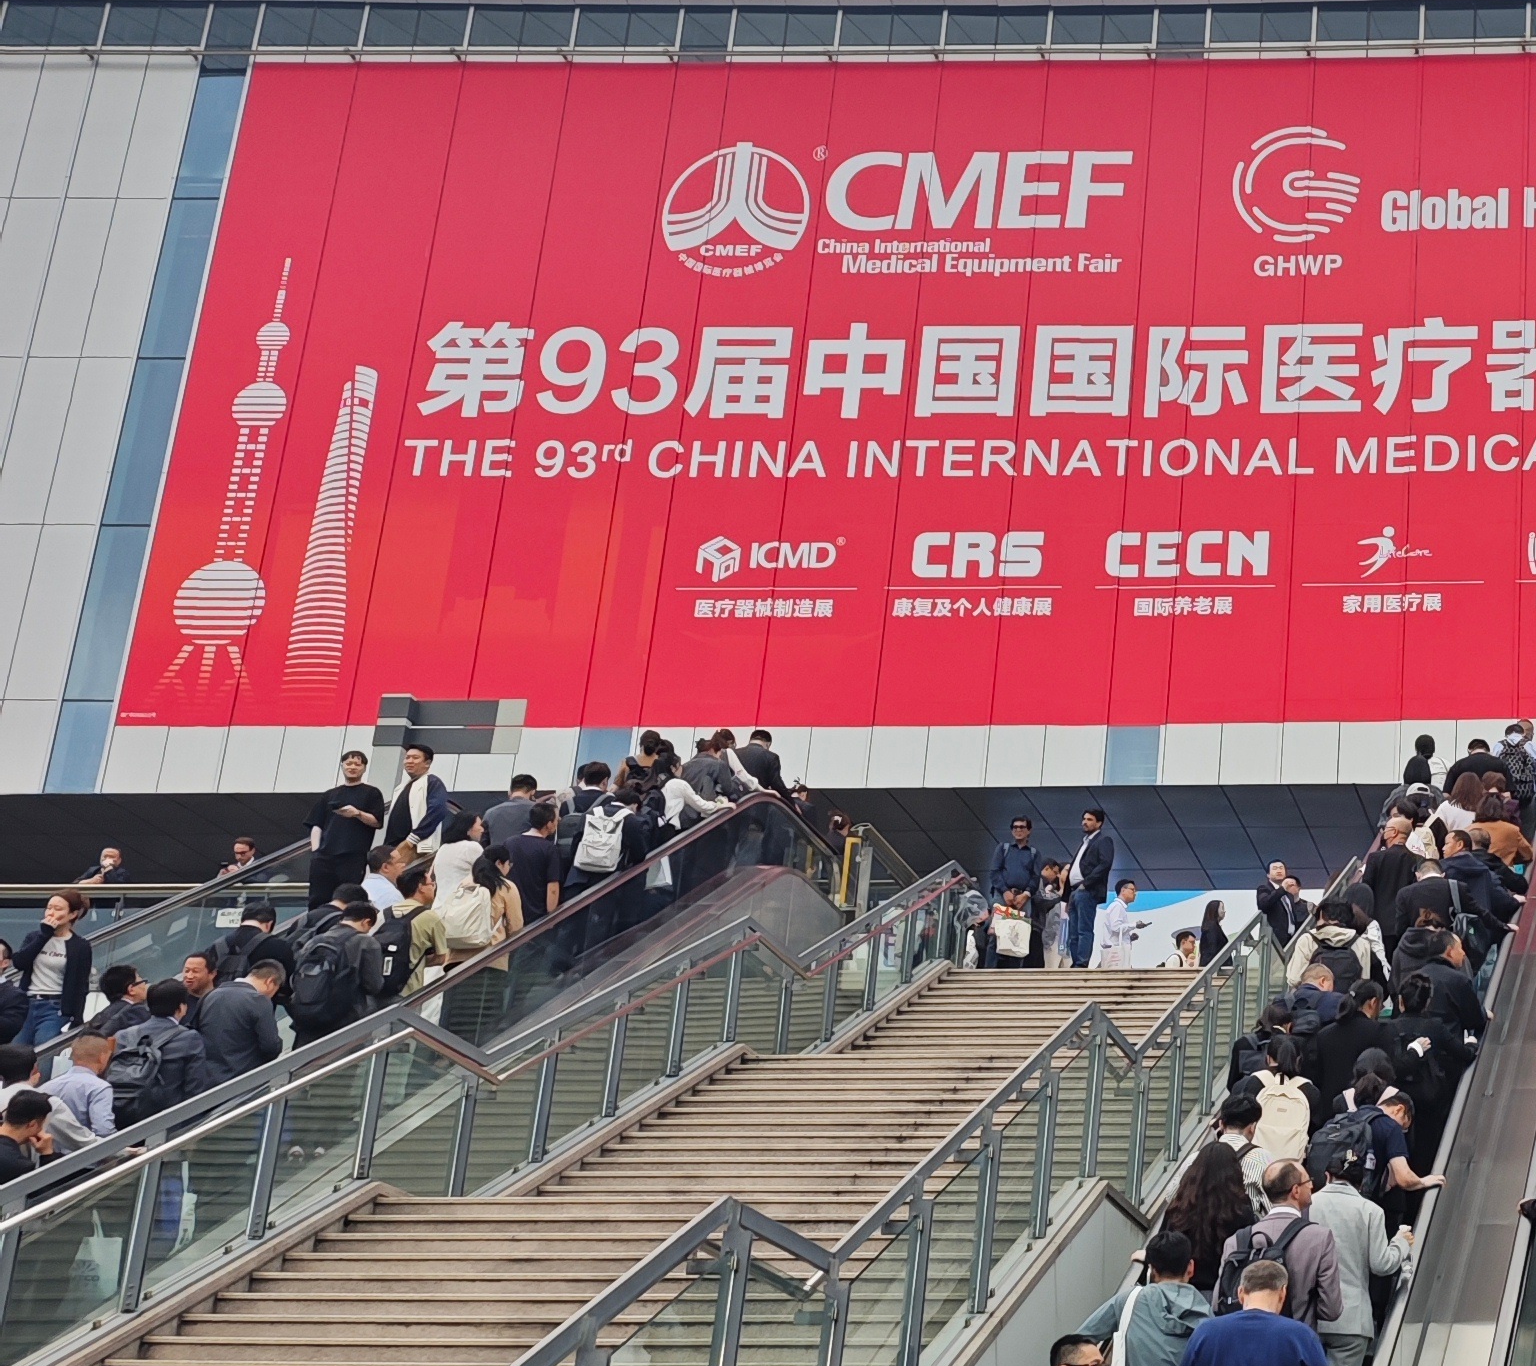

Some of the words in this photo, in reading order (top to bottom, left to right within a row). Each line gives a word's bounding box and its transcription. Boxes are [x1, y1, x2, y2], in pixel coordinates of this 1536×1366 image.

[826, 151, 1133, 231] CMEF
[1381, 188, 1509, 232] Global
[699, 244, 763, 257] CMEF
[818, 238, 868, 255] China
[873, 237, 991, 254] International
[841, 253, 938, 274] Medical
[944, 253, 1072, 277] Equipment
[1078, 253, 1122, 272] Fair
[1254, 255, 1342, 276] GHWP
[405, 439, 515, 477] THE
[649, 441, 826, 478] CHINA
[847, 438, 1314, 477] INTERNATIONAL
[750, 542, 836, 568] ICMD
[912, 532, 1044, 578] CRS
[1105, 531, 1269, 577] CECN
[694, 598, 833, 617] 医疗器械制造展
[892, 597, 1052, 617] 康复及个人健康展
[1134, 596, 1232, 616] 国际养老展
[1343, 593, 1441, 613] 家用医疗展
